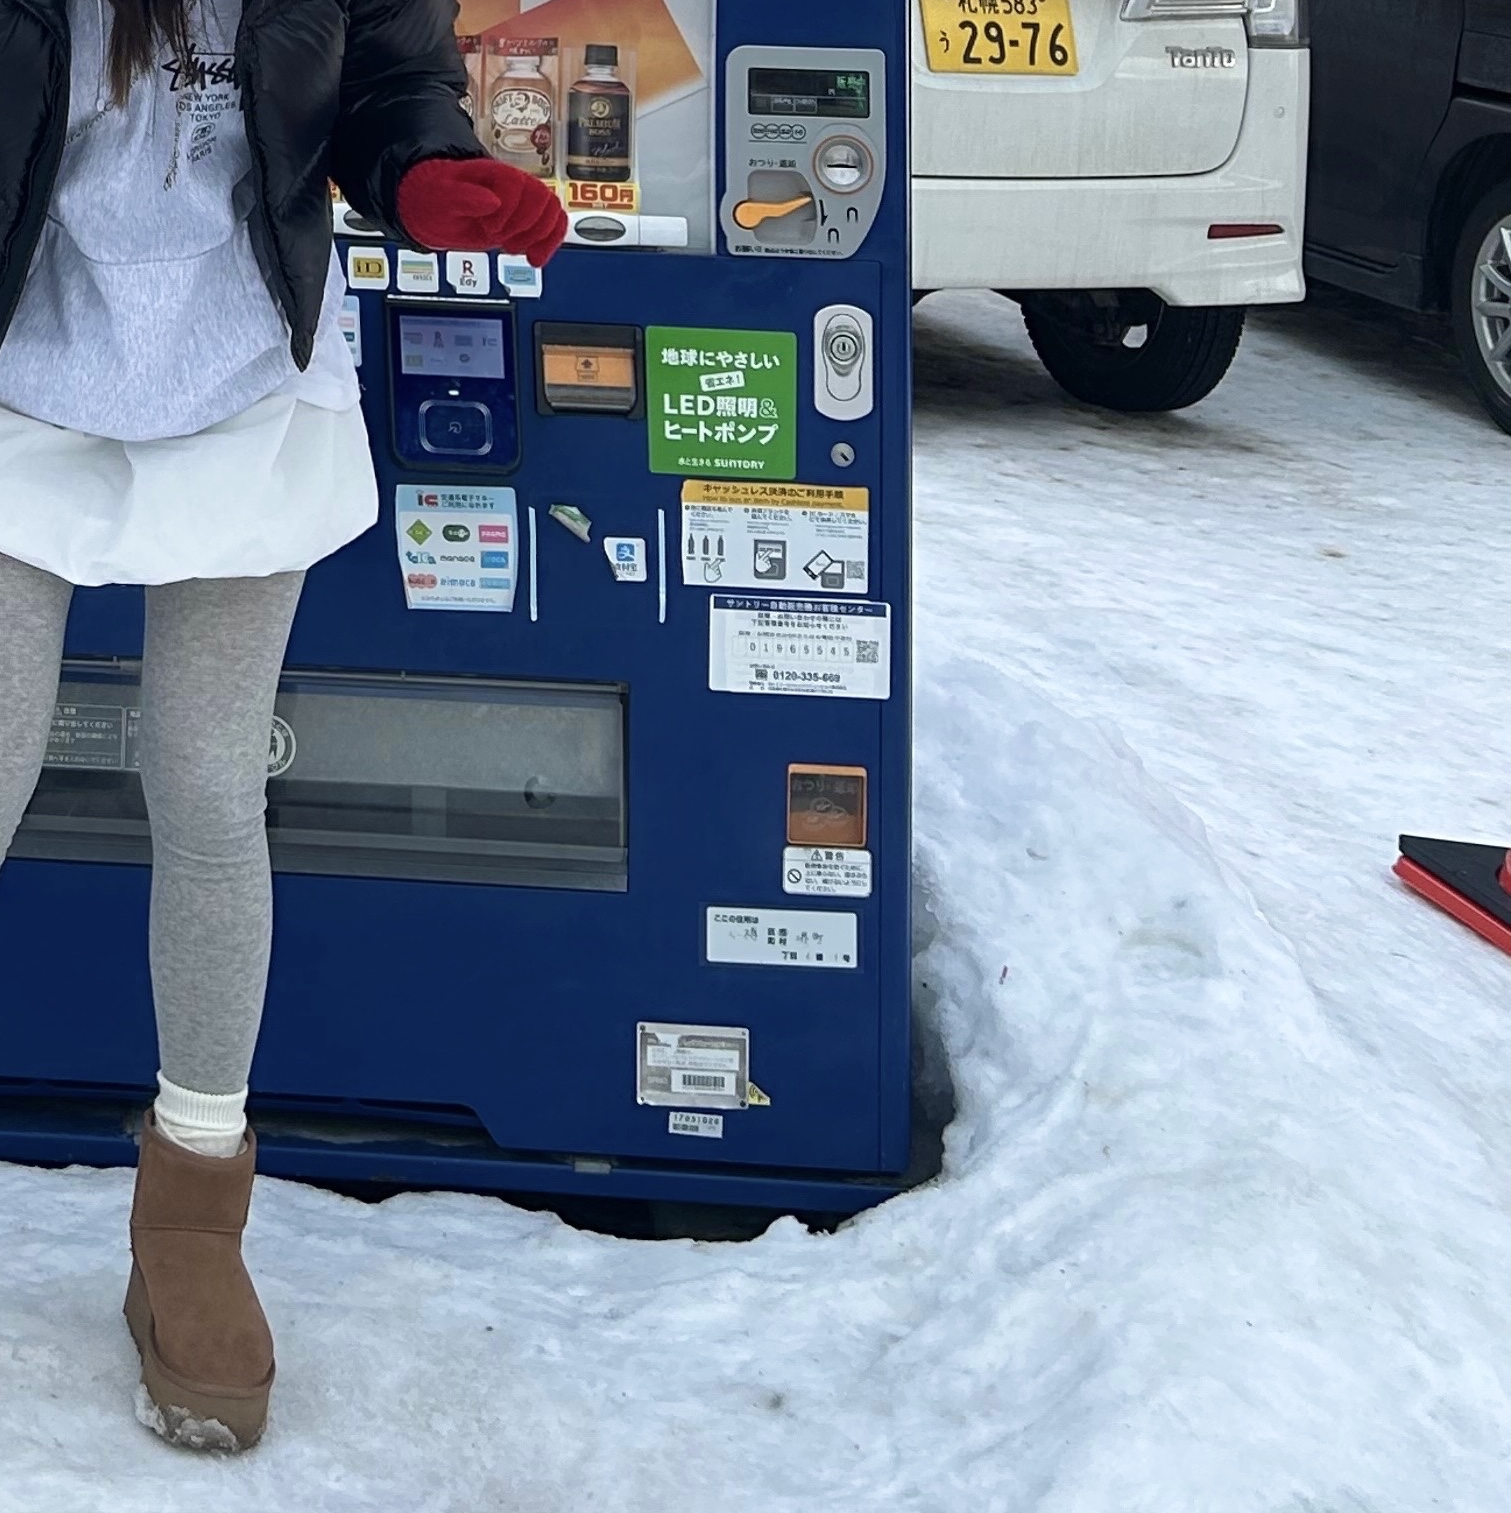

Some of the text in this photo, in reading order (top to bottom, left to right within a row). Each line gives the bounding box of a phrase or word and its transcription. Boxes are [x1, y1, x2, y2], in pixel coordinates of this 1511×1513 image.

[939, 20, 1070, 67] う 29-76
[205, 93, 230, 102] YORK
[190, 112, 221, 123] TOKYO
[502, 113, 537, 126] Latte
[568, 182, 633, 202] 160円
[462, 259, 474, 276] R
[459, 276, 478, 288] Edy
[661, 347, 780, 369] 地球にやさしい
[704, 373, 742, 389] 省エネ!
[663, 393, 779, 419] LED照明&
[663, 420, 779, 445] ヒートポンプ
[714, 457, 766, 470] SUNTORY
